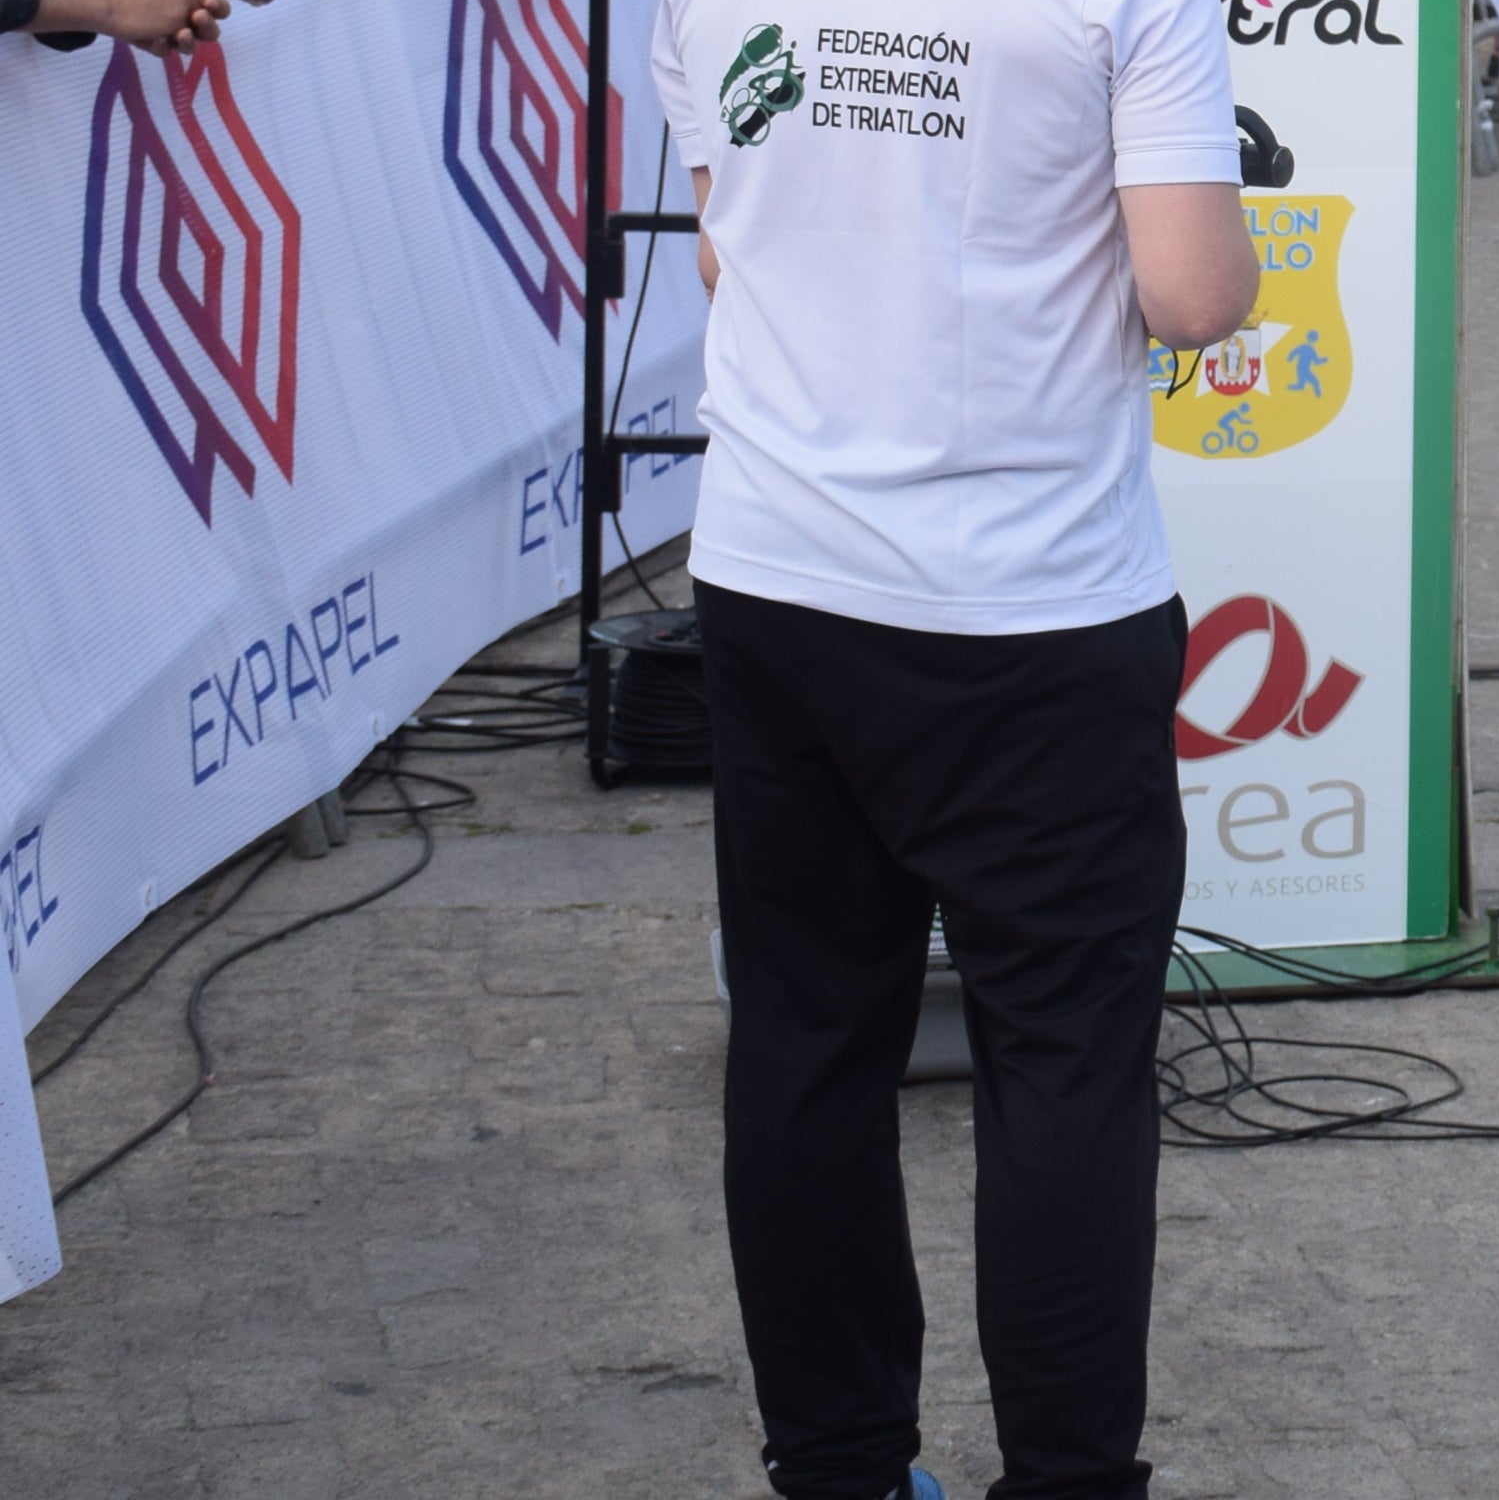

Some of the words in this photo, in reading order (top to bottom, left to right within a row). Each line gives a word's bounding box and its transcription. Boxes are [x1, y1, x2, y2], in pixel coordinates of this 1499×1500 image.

[816, 28, 970, 67] FEDERACIÓN
[820, 65, 961, 102] EXTREMEÑA
[812, 102, 842, 129] DE
[847, 106, 966, 141] TRIATLON
[520, 394, 692, 557] EXPEL
[190, 570, 400, 788] EXPAPEL
[1179, 779, 1366, 863] ea
[1226, 881, 1238, 897] Y
[1250, 874, 1366, 897] ASESORES
